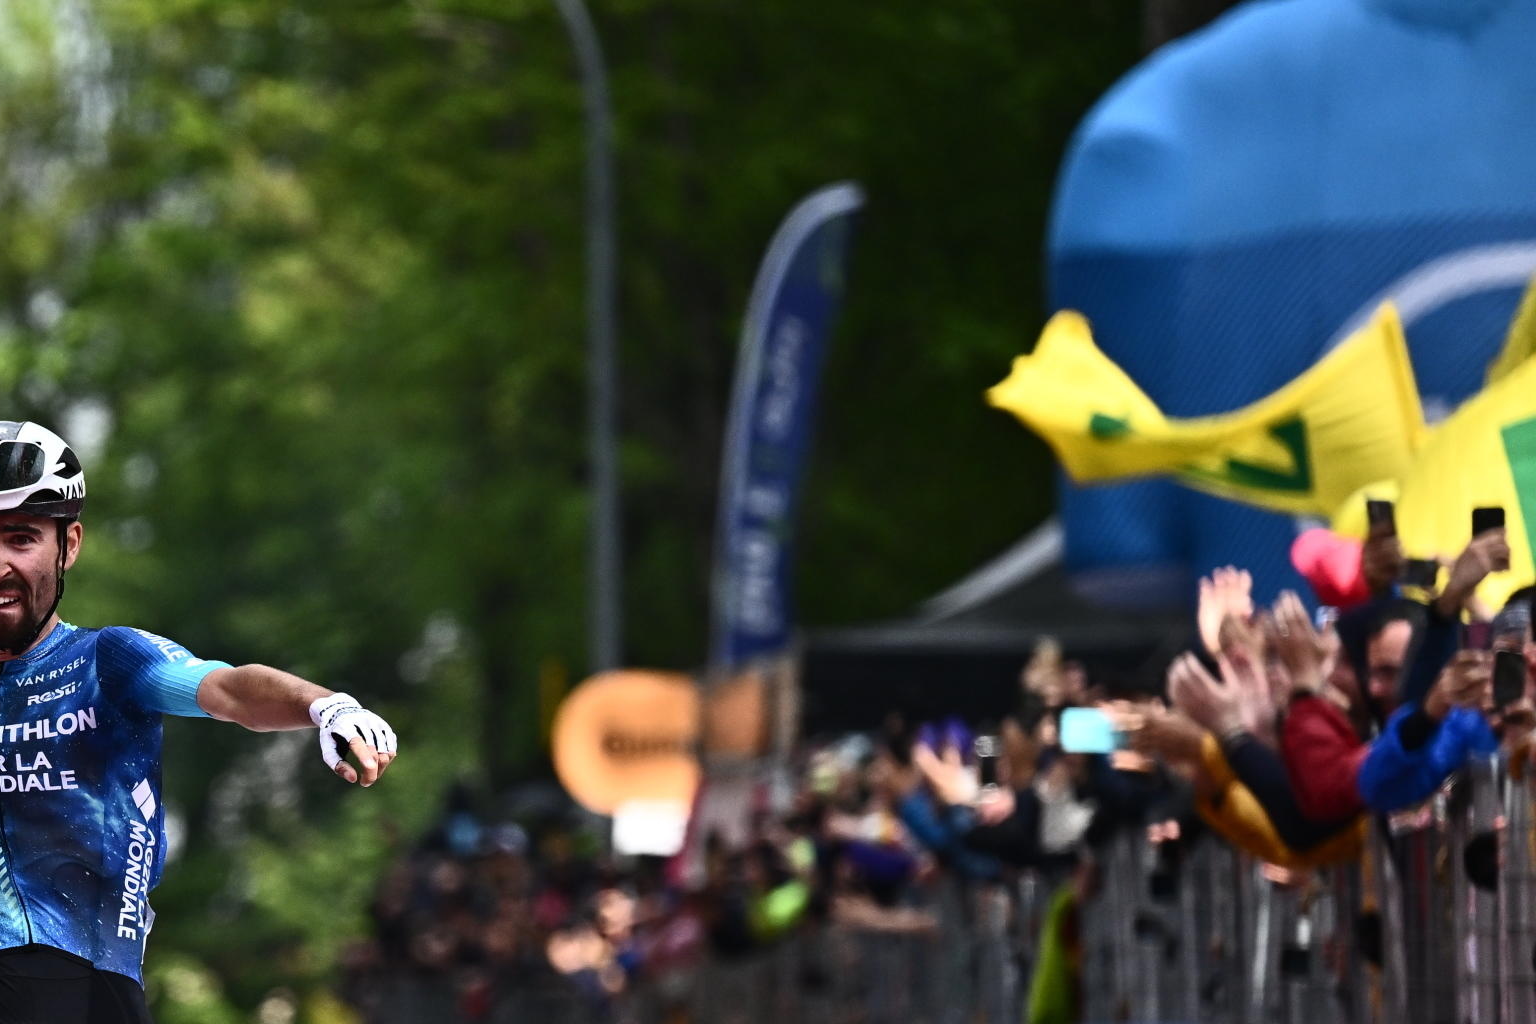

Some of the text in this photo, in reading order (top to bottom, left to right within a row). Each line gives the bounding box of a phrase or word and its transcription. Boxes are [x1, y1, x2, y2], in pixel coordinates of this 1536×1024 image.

[16, 656, 86, 688] VAN RYSEL
[15, 752, 52, 771] LA
[117, 819, 146, 940] MONDIALE
